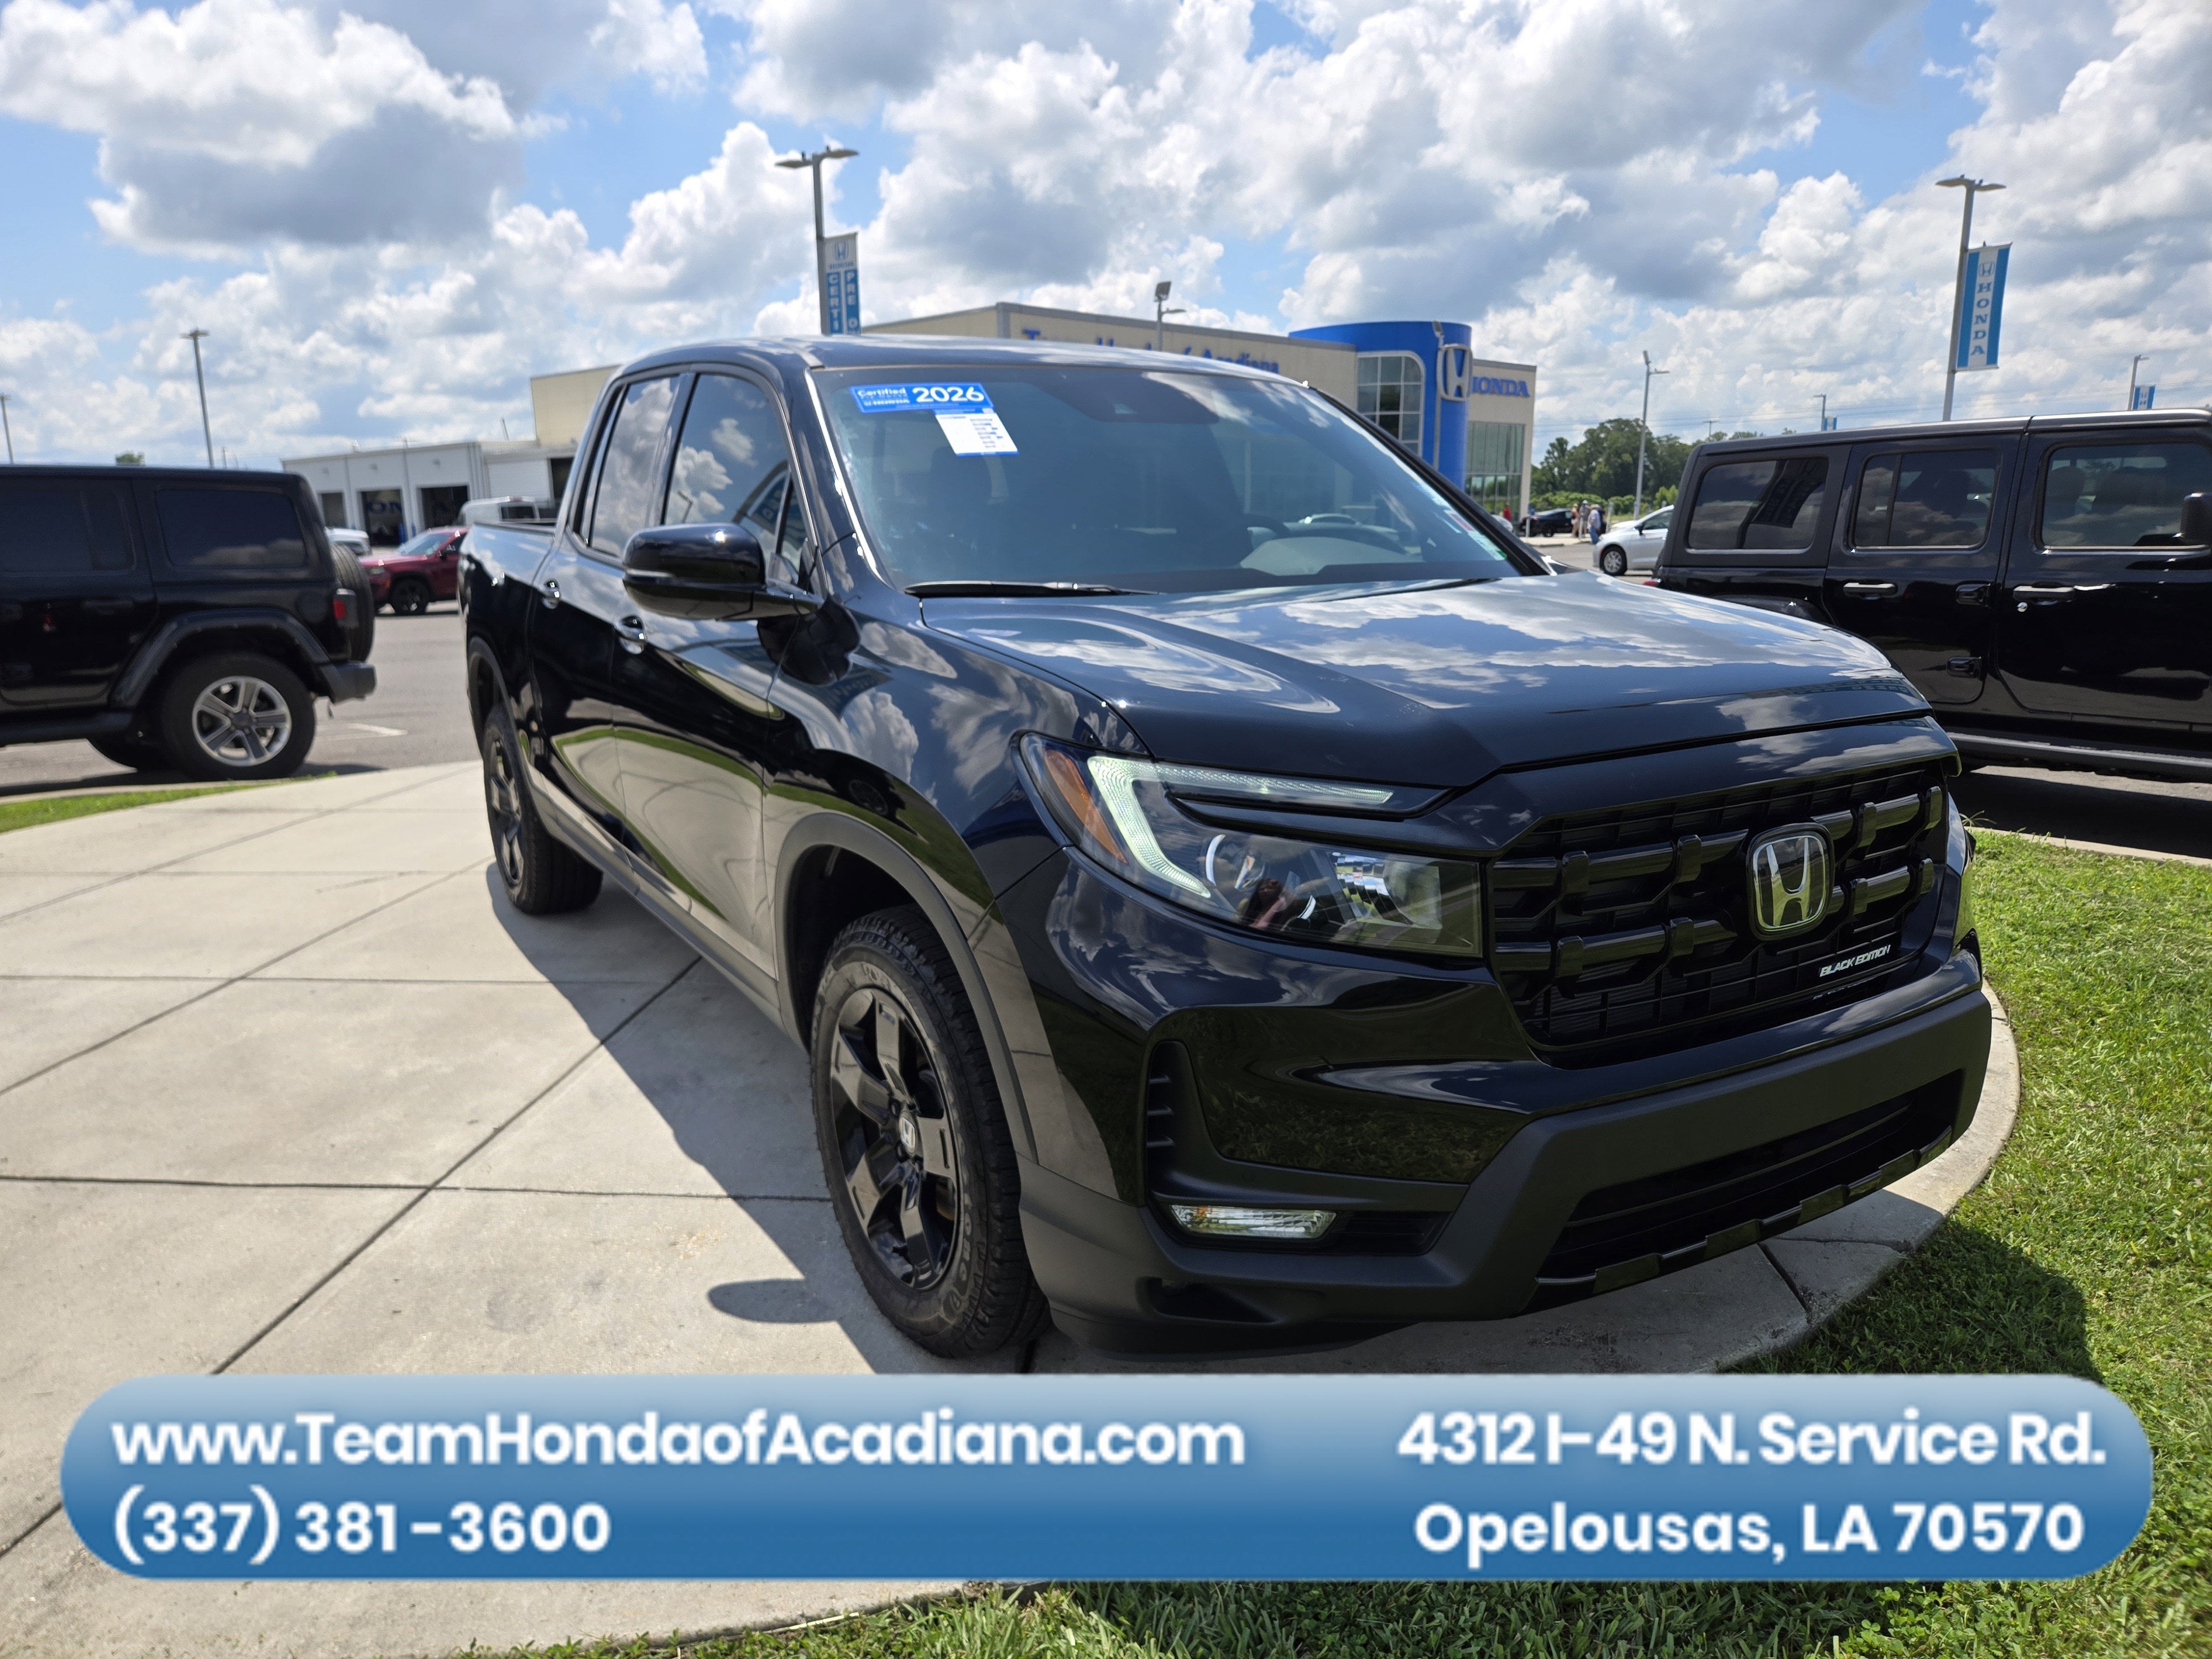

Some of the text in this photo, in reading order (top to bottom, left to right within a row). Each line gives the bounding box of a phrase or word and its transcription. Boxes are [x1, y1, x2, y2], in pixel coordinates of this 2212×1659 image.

[1970, 281, 1992, 356] HONDA
[912, 386, 984, 403] 2026
[1819, 945, 1891, 978] BLACK EDITION
